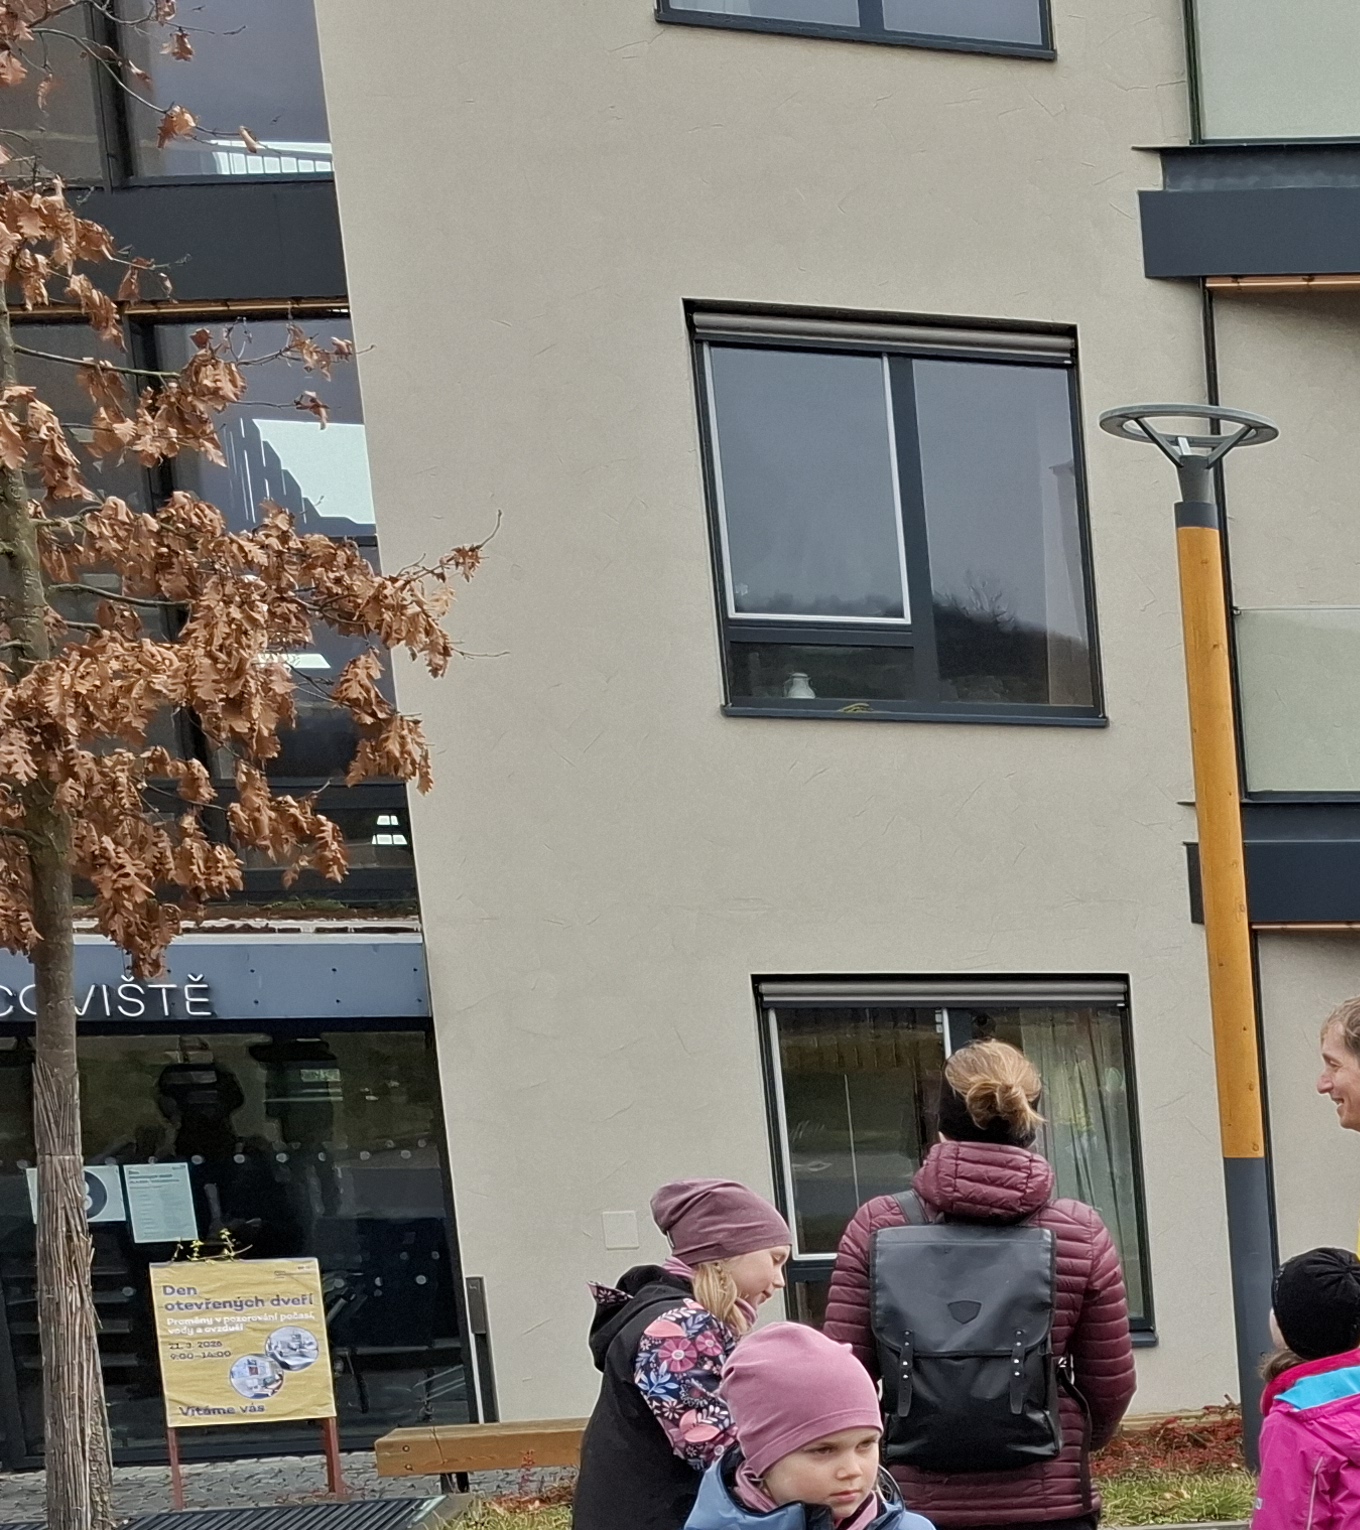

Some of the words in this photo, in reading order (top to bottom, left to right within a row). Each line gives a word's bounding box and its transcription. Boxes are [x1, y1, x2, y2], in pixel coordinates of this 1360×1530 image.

[162, 1285, 197, 1296] Den
[164, 1296, 265, 1312] otevřených
[270, 1293, 313, 1306] dveří
[168, 1326, 194, 1336] vody
[178, 1404, 236, 1417] Vítáme
[240, 1402, 265, 1413] vás
